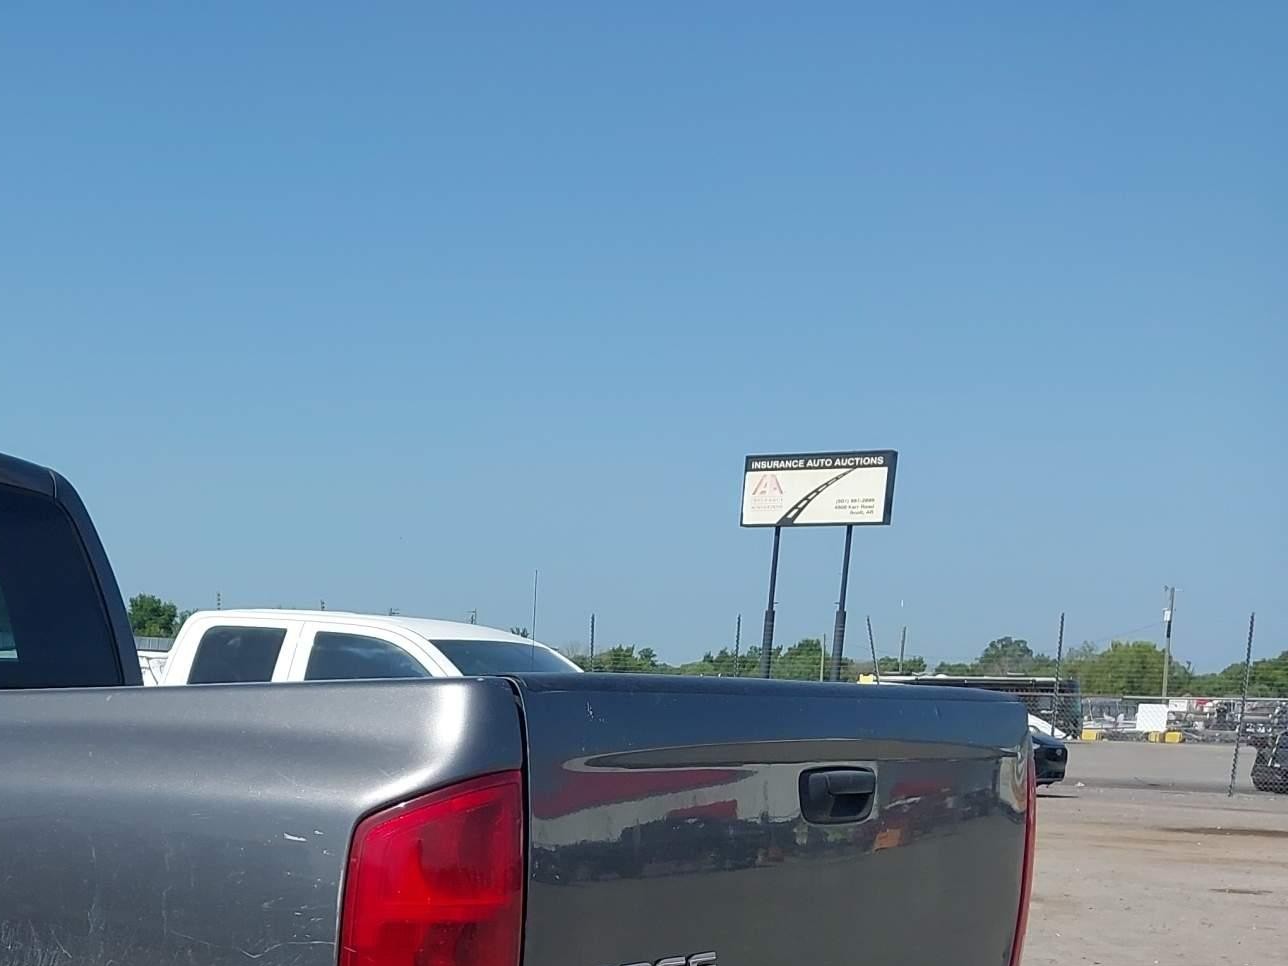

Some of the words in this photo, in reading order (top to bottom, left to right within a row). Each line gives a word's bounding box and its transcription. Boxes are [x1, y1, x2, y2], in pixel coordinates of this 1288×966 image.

[751, 459, 805, 470] INSURANCE
[806, 457, 833, 468] AUTO
[834, 455, 884, 467] AUCTIONS
